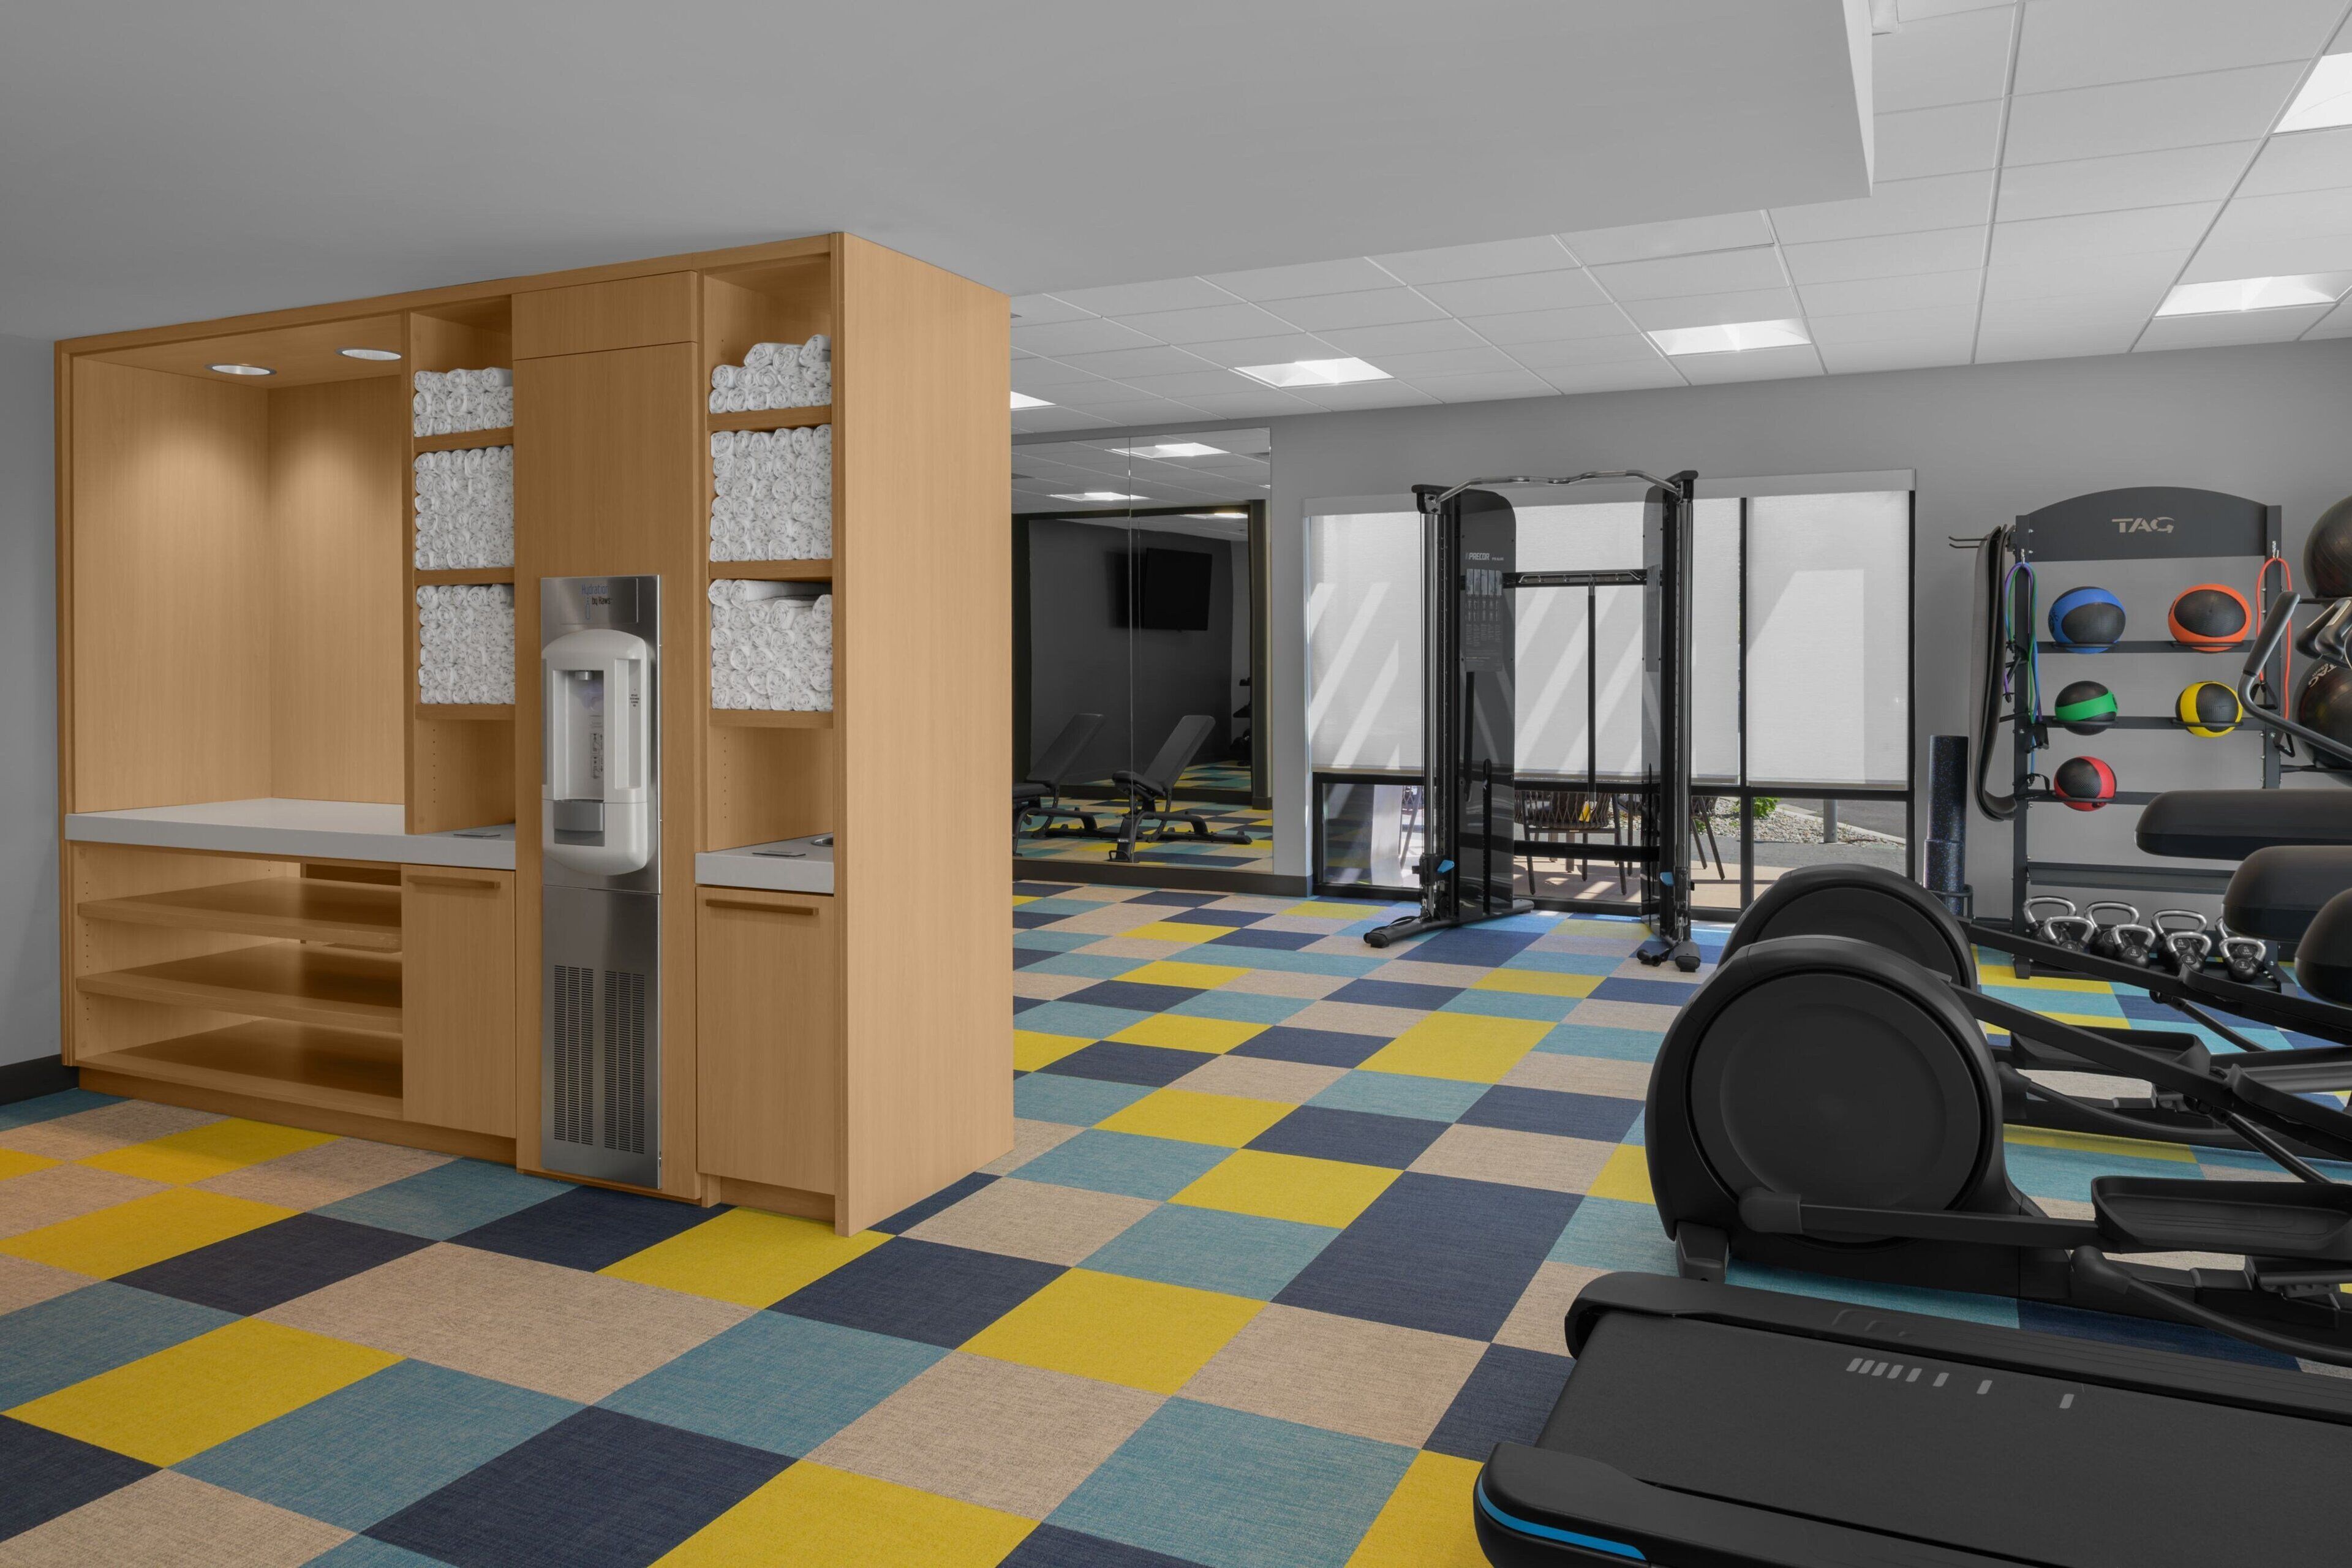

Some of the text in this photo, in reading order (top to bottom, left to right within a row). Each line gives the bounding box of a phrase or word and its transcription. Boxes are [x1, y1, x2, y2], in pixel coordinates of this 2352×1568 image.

[2111, 516, 2174, 533] TAG
[1468, 552, 1490, 560] PRECOR
[581, 583, 608, 596] Hydration
[2308, 664, 2337, 687] TAG
